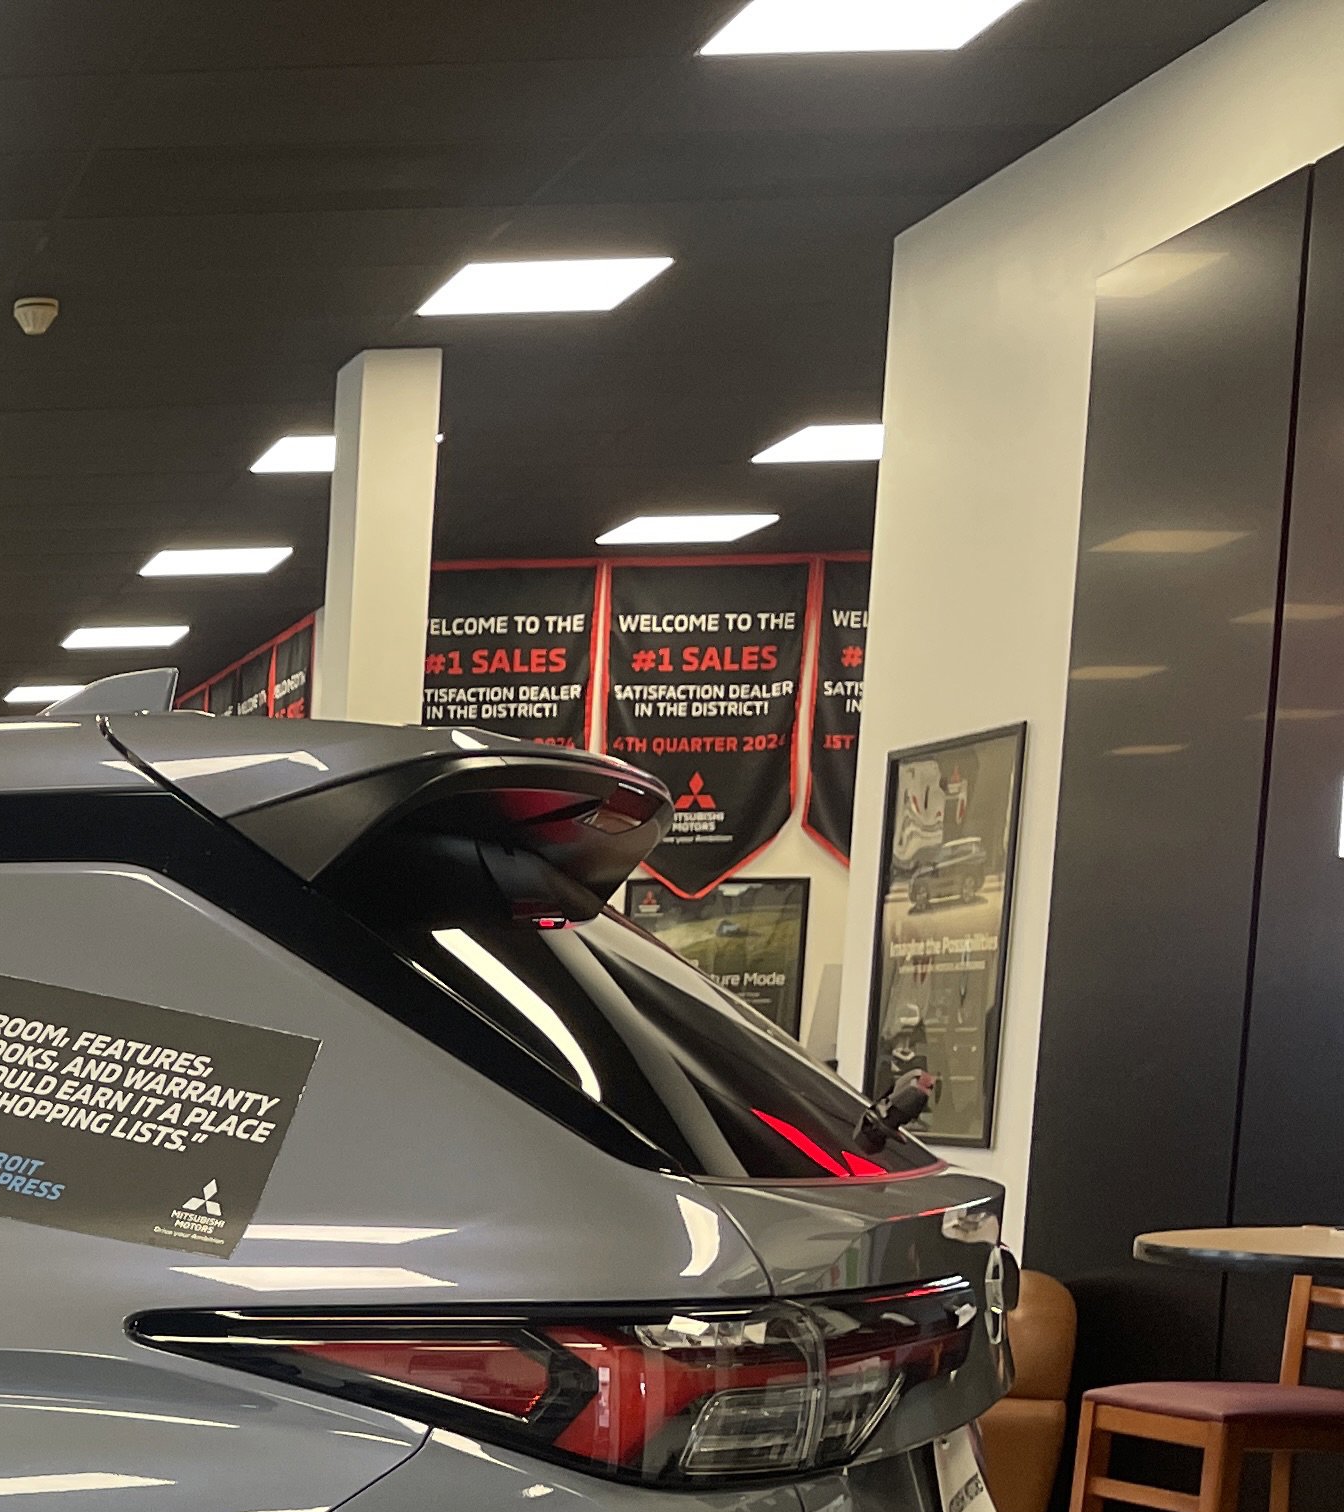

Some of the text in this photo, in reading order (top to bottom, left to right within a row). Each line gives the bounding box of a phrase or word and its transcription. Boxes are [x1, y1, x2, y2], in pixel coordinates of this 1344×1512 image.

[429, 614, 586, 635] ELCOME TO THE
[618, 611, 796, 633] WELCOME TO THE
[425, 648, 567, 675] #1 SALES
[632, 645, 778, 672] #1 SALES
[424, 684, 582, 703] TISFACTION DEALER
[614, 680, 794, 701] SATISFACTION DEALER
[426, 705, 443, 720] IN
[447, 704, 477, 719] THE
[634, 702, 652, 717] IN
[656, 701, 687, 717] THE
[613, 736, 647, 753] 4TH
[652, 736, 738, 756] QUARTER
[743, 972, 786, 986] Mode
[72, 1032, 214, 1077] FEATURES,
[61, 1056, 121, 1085] AND
[123, 1068, 280, 1116] WARRANTY
[57, 1080, 134, 1113] EARN
[131, 1095, 166, 1118] IT
[158, 1101, 183, 1124] A
[181, 1107, 276, 1143] PLACE
[171, 1210, 225, 1228] MITSUBISHI
[174, 1220, 214, 1234] MOTORS
